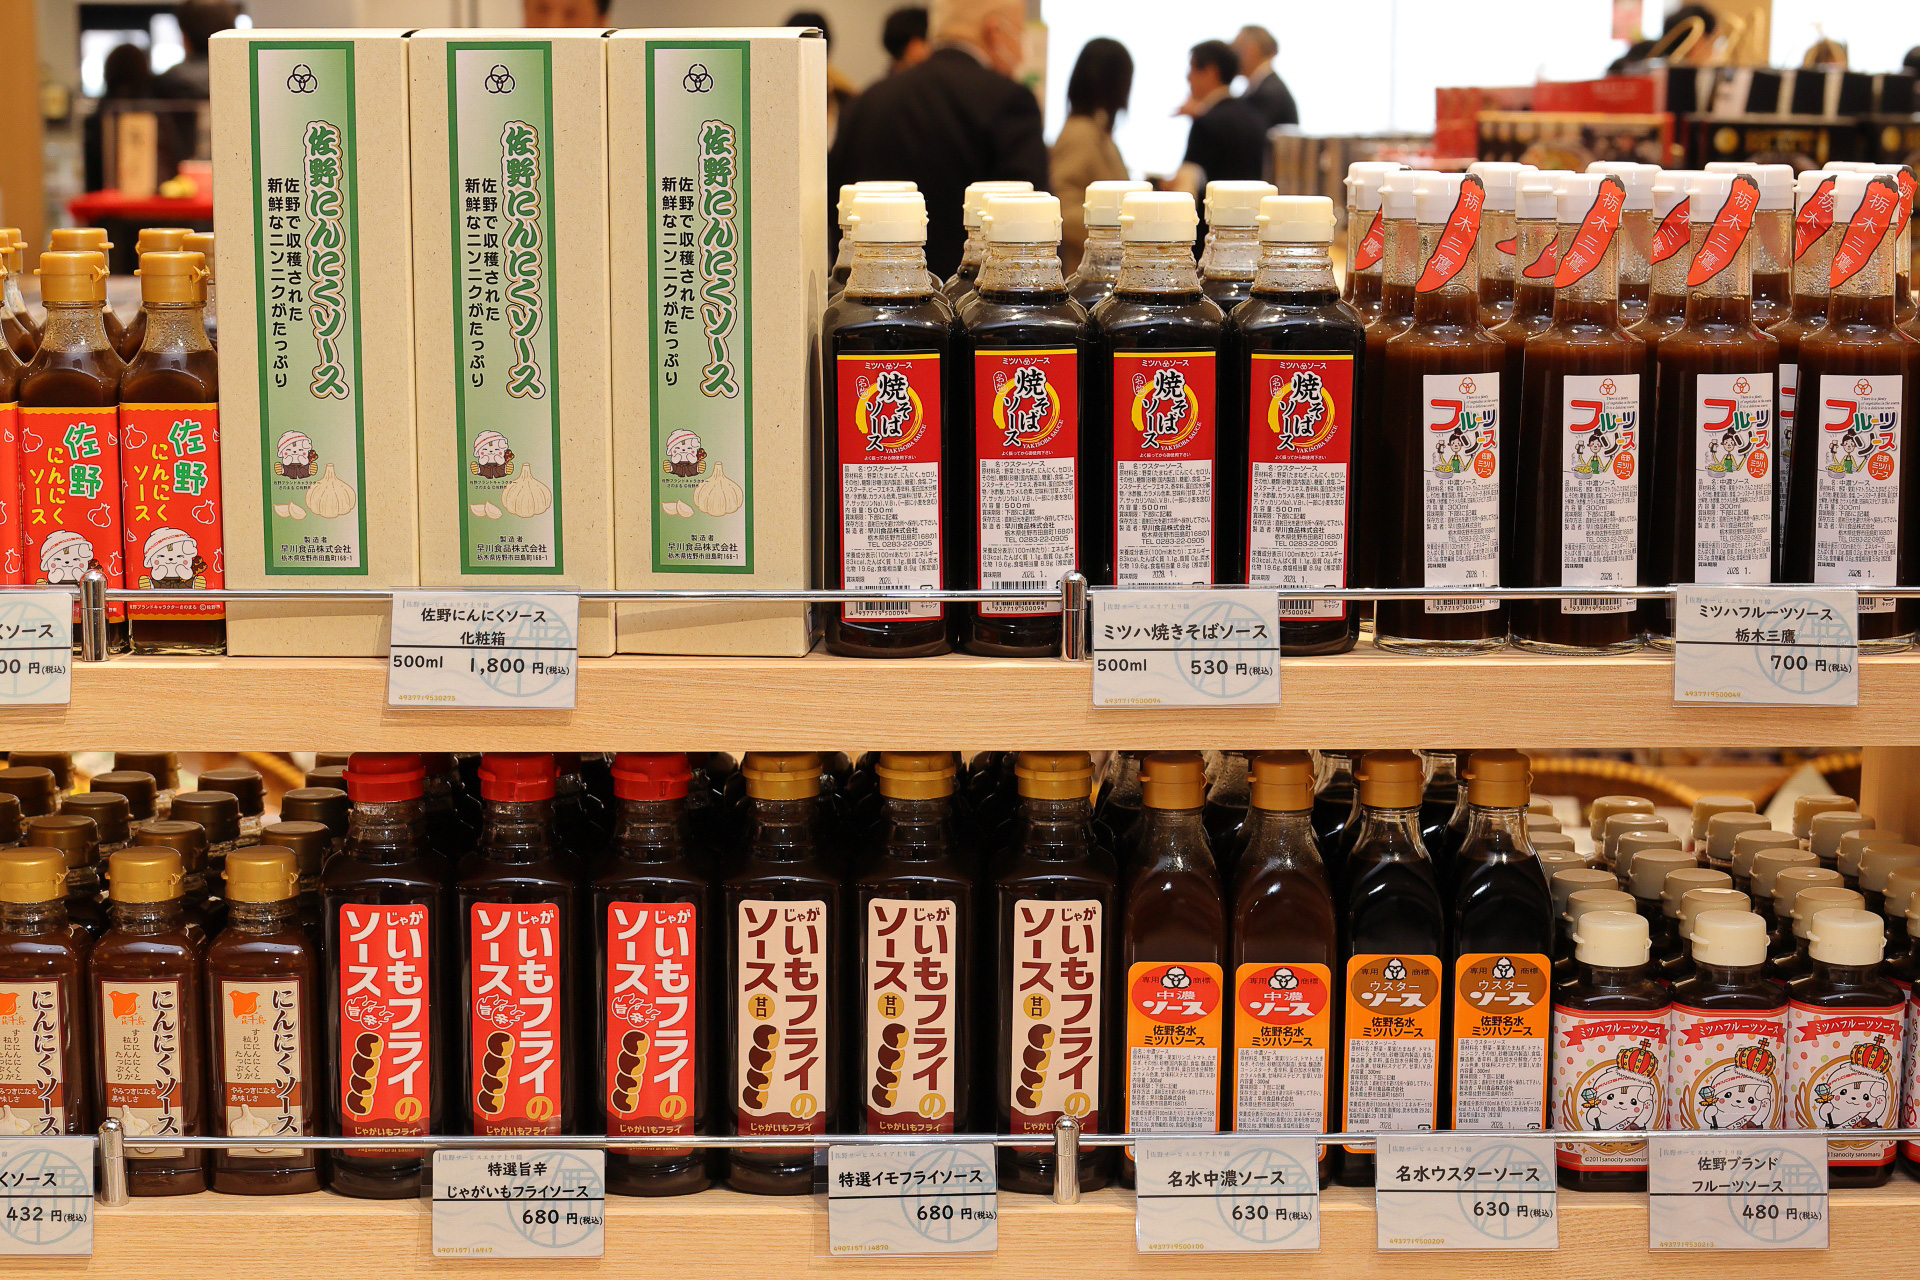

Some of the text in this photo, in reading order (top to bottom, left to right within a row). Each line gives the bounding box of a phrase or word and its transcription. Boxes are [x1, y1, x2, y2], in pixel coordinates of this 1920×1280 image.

[284, 177, 304, 322] 佐野で収穫された
[482, 178, 500, 321] 佐野で収穫された
[678, 177, 695, 320] 佐野で収穫された
[306, 122, 348, 398] 佐野にんにくソース
[502, 121, 545, 398] 佐野にんにくソース
[700, 121, 739, 397] 佐野にんにくソース
[268, 177, 289, 388] 新鮮なニンニクがたっぷり
[465, 178, 485, 387] 新鮮なニンニクがたっぷり
[661, 177, 679, 386] 新鮮なニンニクがたっぷり
[1003, 396, 1022, 446] ソース
[1141, 398, 1160, 448] ソース
[1430, 398, 1496, 431] フルーツ
[1570, 400, 1635, 431] フルーツ
[1704, 399, 1769, 430] フルーツ
[1825, 399, 1896, 431] フルーツ
[865, 401, 884, 451] ソース
[1277, 400, 1296, 450] ソース
[1461, 430, 1496, 454] ソース
[1600, 431, 1635, 455] ソース
[1734, 430, 1770, 454] ソース
[1854, 432, 1895, 455] ソース
[63, 422, 104, 499] 佐野
[168, 419, 209, 495] 佐野
[47, 447, 66, 524] にんにく
[152, 443, 170, 521] にんにく
[30, 468, 47, 525] ソース
[134, 465, 151, 522] ソース
[421, 608, 546, 623] 佐野にんにくソース
[1700, 605, 1833, 621] ミツハフルーツソース
[460, 631, 505, 646] 化粧箱
[1104, 623, 1268, 640] ミツハ焼きそばソース
[1735, 628, 1795, 643] 栃木三鷹
[393, 655, 443, 668] 500ml
[470, 658, 525, 675] 1,800
[1097, 659, 1147, 672] 500ml
[1191, 660, 1228, 675] 530
[1770, 655, 1808, 670] 700
[346, 910, 381, 997] ソース
[477, 909, 512, 997] ソース
[613, 908, 649, 995] ソース
[744, 907, 778, 993] ソース
[874, 906, 908, 992] ソース
[1019, 907, 1055, 993] ソース
[1370, 981, 1420, 992] ウスター
[1478, 980, 1528, 991] ウスター
[1156, 990, 1196, 1001] 中濃
[1263, 991, 1304, 1002] 中濃
[1361, 992, 1427, 1007] ソース
[1470, 991, 1535, 1006] ソース
[755, 997, 768, 1018] 甘口
[884, 995, 898, 1017] 甘口
[1029, 996, 1043, 1017] 甘口
[1142, 1001, 1208, 1016] ソース
[1249, 1002, 1316, 1016] ソース
[1371, 1017, 1415, 1028] 佐野名水
[1480, 1016, 1525, 1026] 佐野名水
[1699, 1019, 1780, 1037] ミツハフルーツソース
[1816, 1018, 1897, 1033] ミツハフルーツソース
[1153, 1025, 1197, 1036] 佐野名水
[1260, 1026, 1305, 1037] 佐野名水
[1362, 1027, 1424, 1038] ミツハソース
[1471, 1026, 1533, 1037] ミツハソース
[1580, 1023, 1661, 1037] ミツハフルーツソース
[1143, 1035, 1206, 1047] ミツハソース
[1251, 1036, 1313, 1047] ミツハソース
[32, 990, 61, 1135] にんにくソース
[132, 1029, 141, 1081] すりにんにくと
[152, 990, 180, 1135] にんにくソース
[272, 989, 299, 1135] にんにくソース
[354, 1126, 421, 1136] じゃがいもフライ
[619, 1124, 682, 1134] じゃがいもフライ
[750, 1123, 813, 1132] じゃがいもフライ
[879, 1121, 942, 1132] じゃがいもフライ
[488, 1162, 547, 1176] 特選旨辛
[1698, 1157, 1778, 1171] 佐野ブランド
[839, 1170, 983, 1187] 特選イモフライソース
[1167, 1170, 1285, 1187] 名水中濃ソース
[1396, 1165, 1540, 1182] 名水ウスターソース
[447, 1185, 589, 1199] じゃがいもフライソース
[1692, 1181, 1783, 1192] フルーツソース
[6, 1206, 43, 1221] 432
[522, 1210, 559, 1224] 680
[917, 1205, 954, 1220] 680
[1232, 1206, 1268, 1220] 630
[1474, 1202, 1510, 1217] 630
[1743, 1204, 1779, 1219] 480
